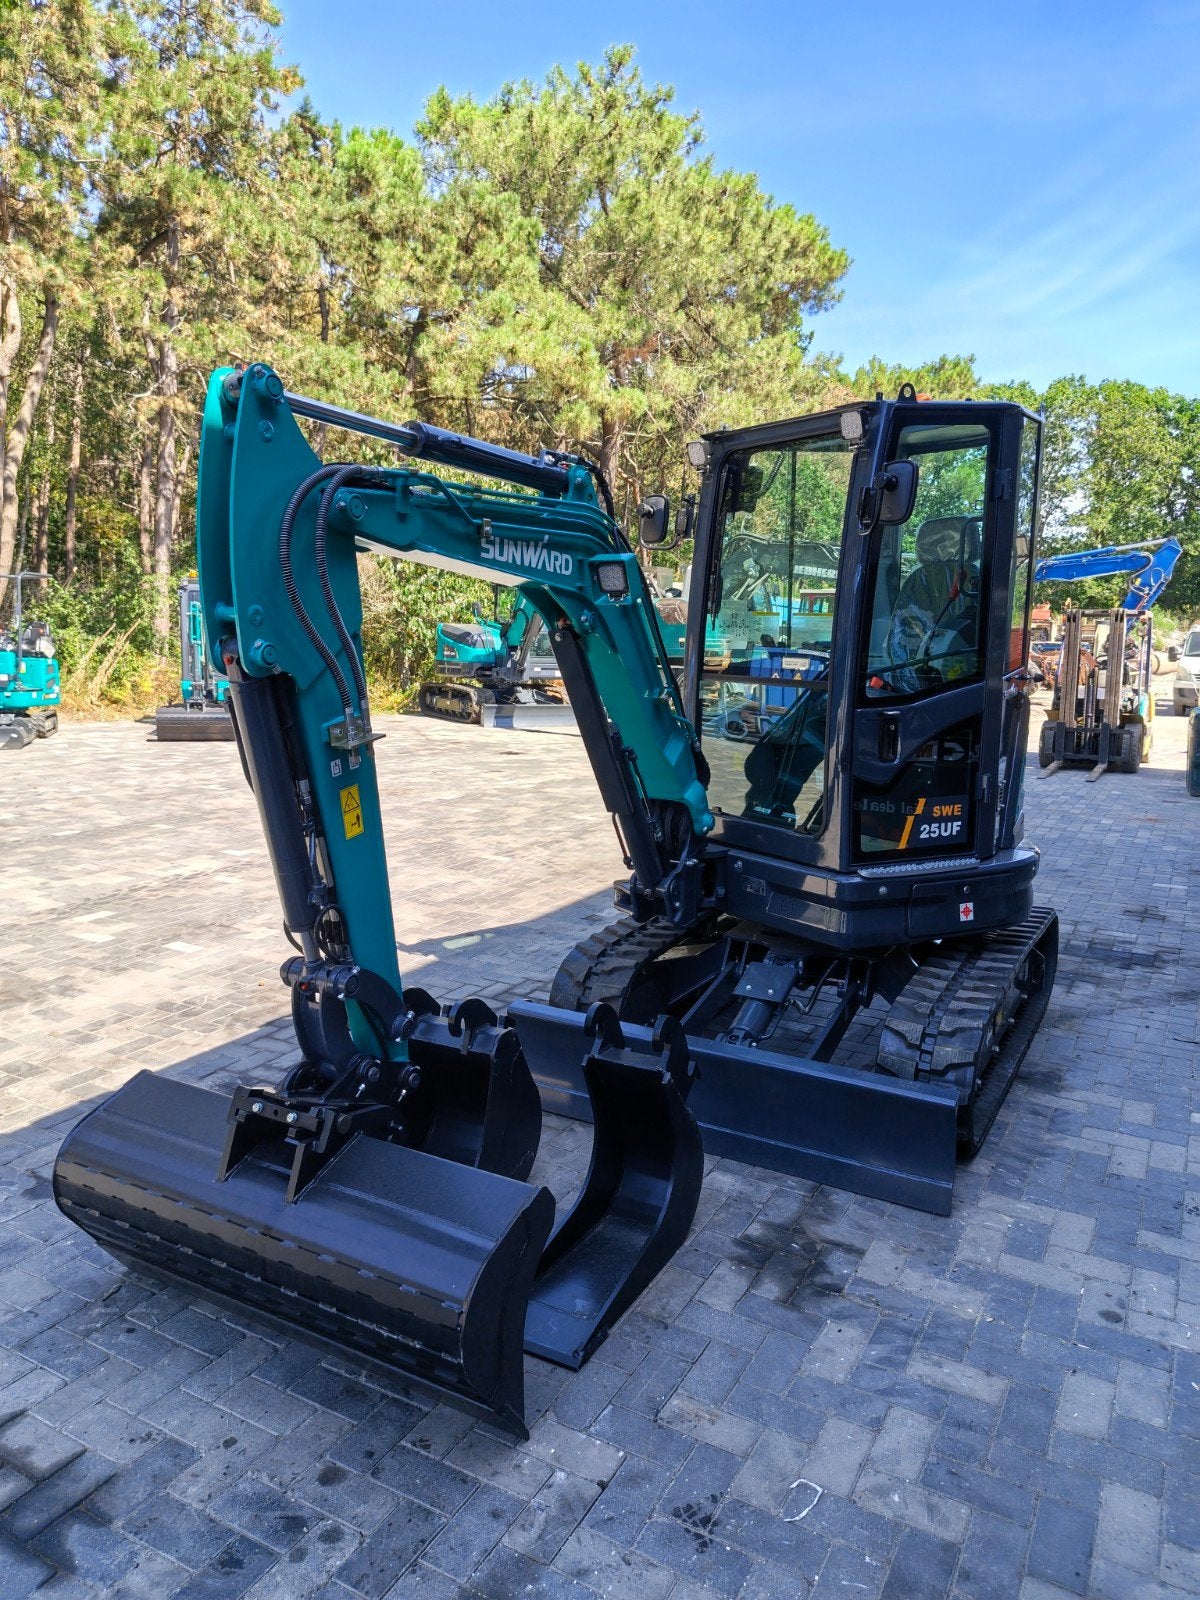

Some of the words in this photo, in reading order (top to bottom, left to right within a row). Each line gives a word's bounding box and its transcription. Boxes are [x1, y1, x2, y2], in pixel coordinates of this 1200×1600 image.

[480, 534, 573, 576] SUNWARD
[932, 804, 962, 818] SWE
[919, 821, 962, 839] 25UF
